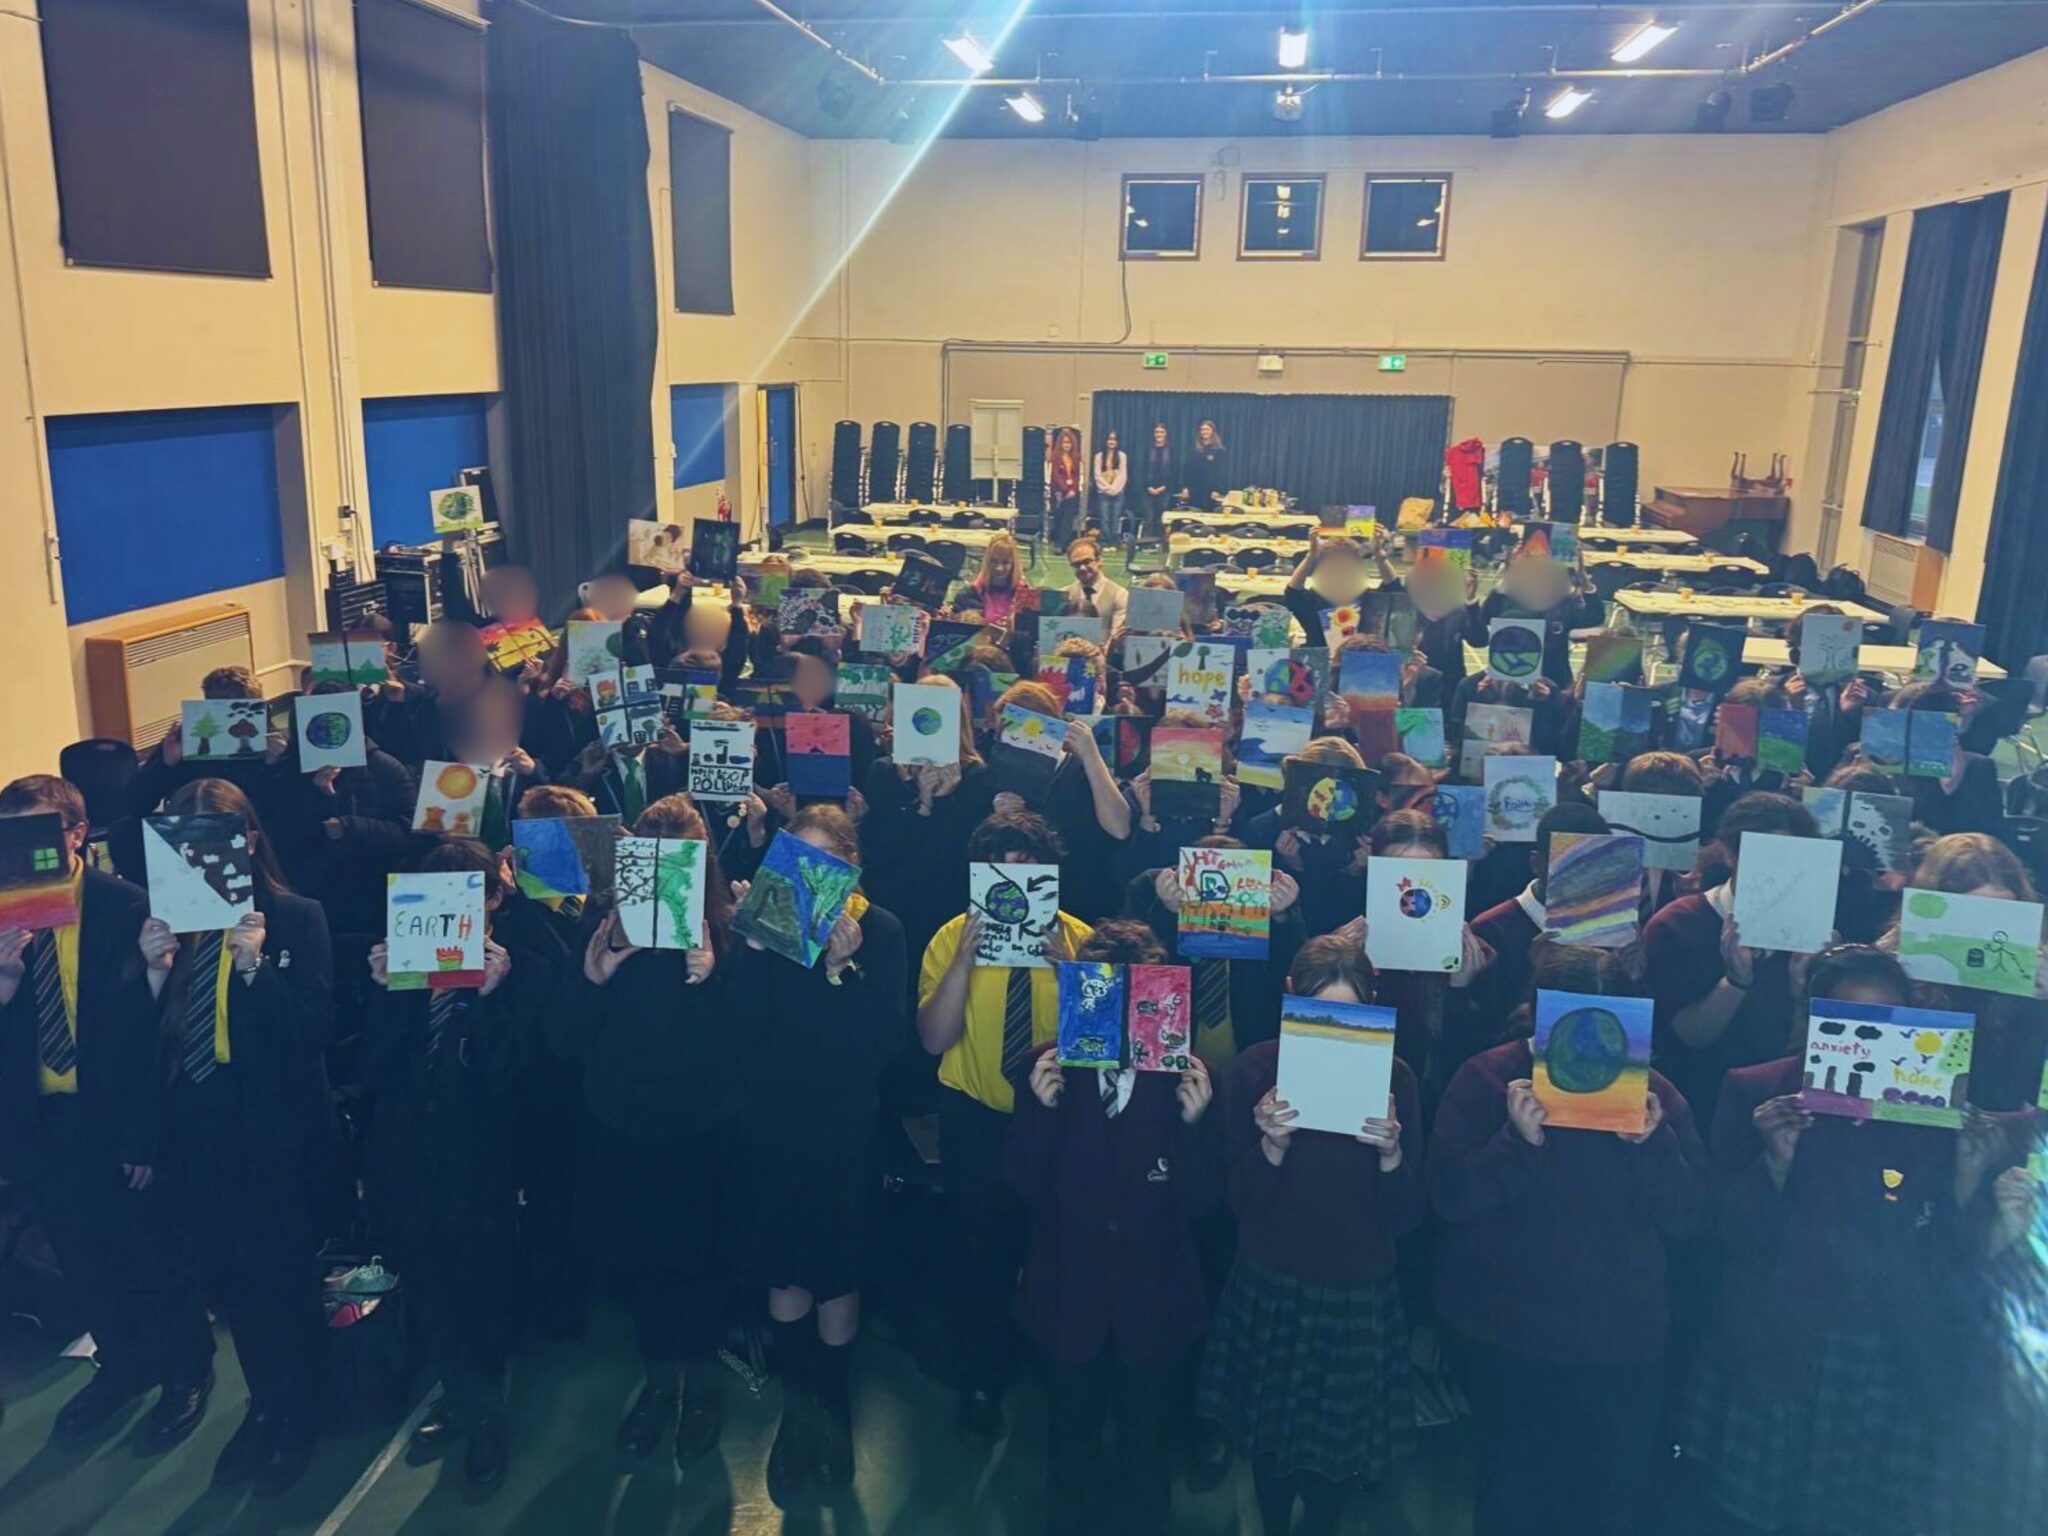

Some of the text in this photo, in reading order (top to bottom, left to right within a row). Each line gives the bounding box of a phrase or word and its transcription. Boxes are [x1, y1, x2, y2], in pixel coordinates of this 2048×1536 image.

[1177, 663, 1225, 694] hope
[394, 910, 472, 940] EARTH
[1810, 1041, 1871, 1059] anxiety
